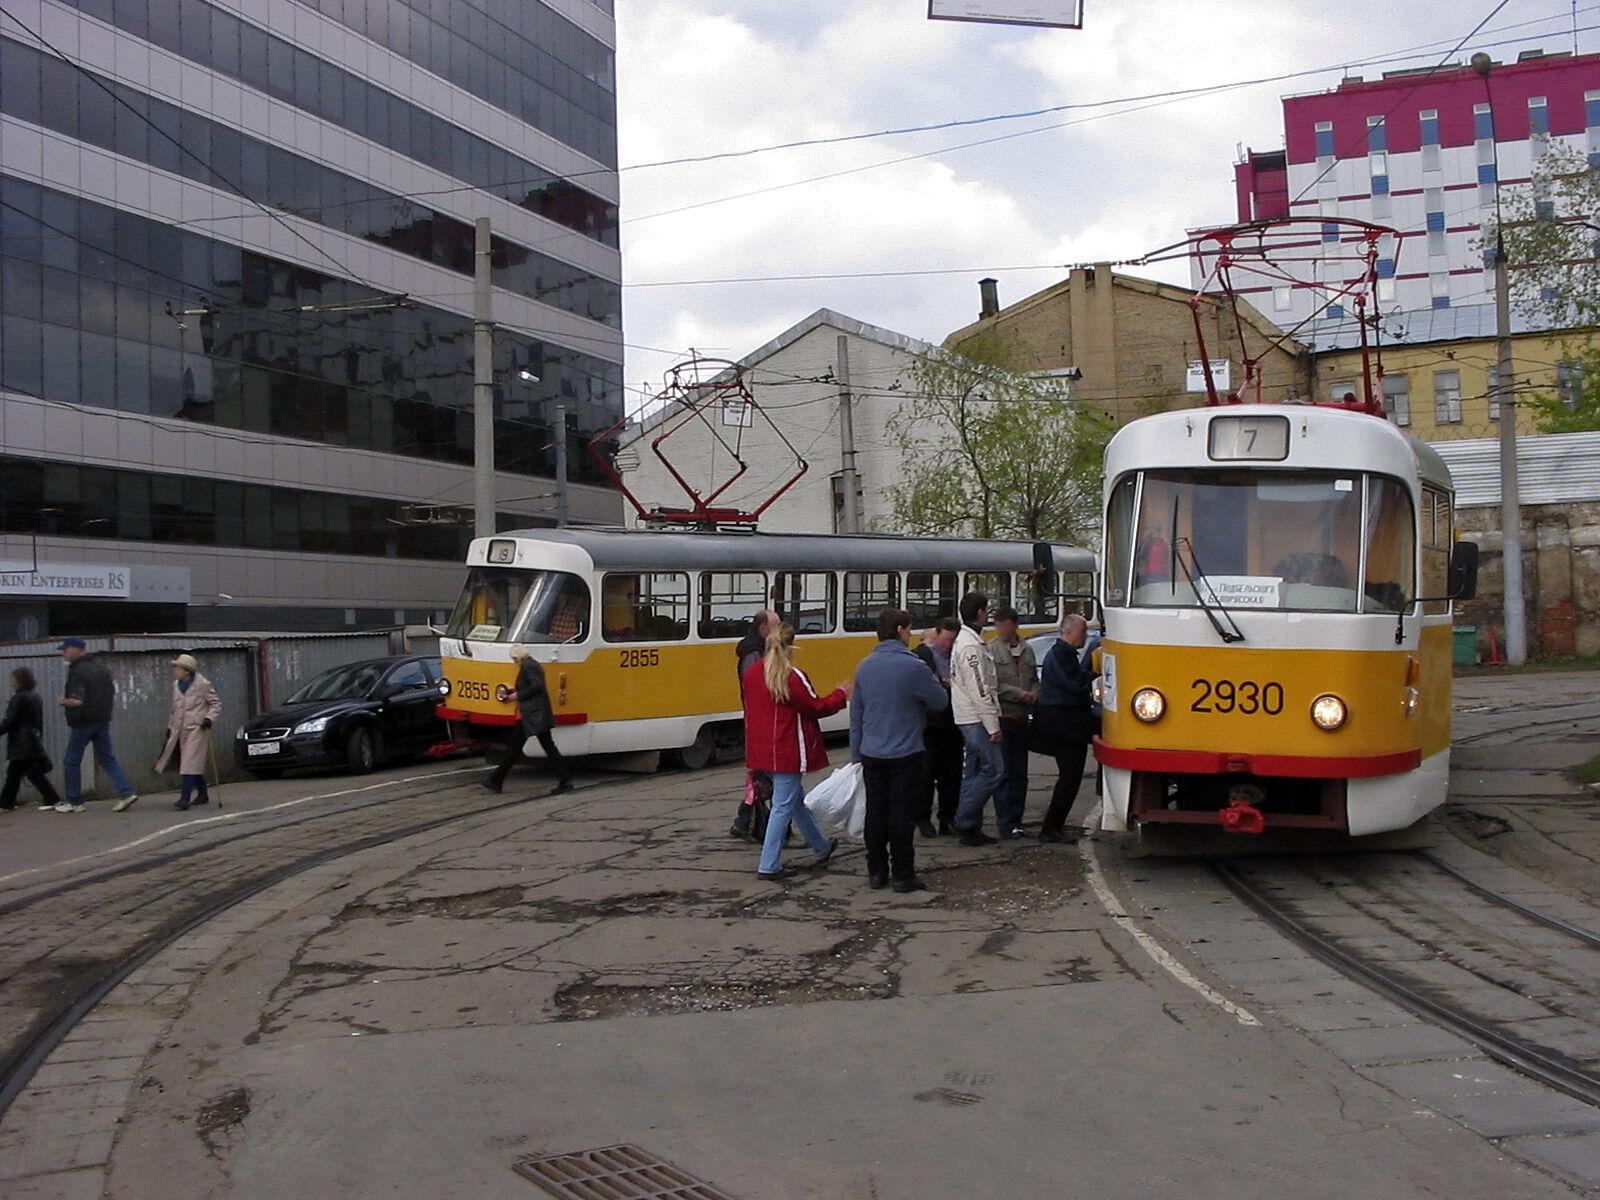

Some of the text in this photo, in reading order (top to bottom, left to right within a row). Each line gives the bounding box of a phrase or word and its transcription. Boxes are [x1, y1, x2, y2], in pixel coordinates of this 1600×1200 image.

[1243, 429, 1258, 452] 7
[0, 574, 25, 587] KIN
[108, 573, 125, 590] RS
[620, 649, 659, 668] 2855
[457, 680, 490, 700] 2855
[1191, 678, 1284, 715] 2930
